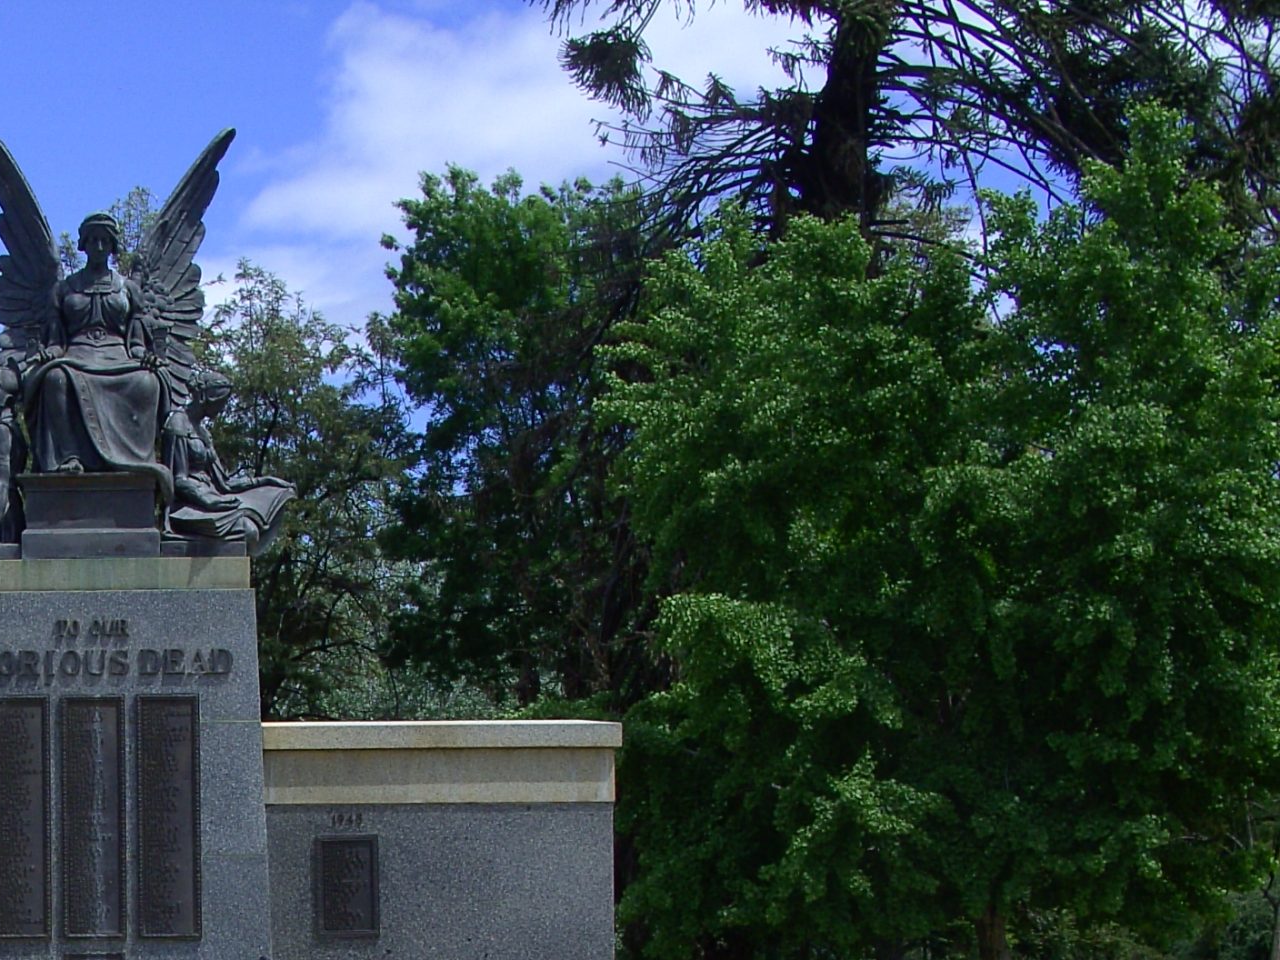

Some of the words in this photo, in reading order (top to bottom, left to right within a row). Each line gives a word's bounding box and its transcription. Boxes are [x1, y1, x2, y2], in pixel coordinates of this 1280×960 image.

[53, 619, 81, 638] TO
[89, 618, 130, 638] OUR
[136, 648, 234, 677] DEAD
